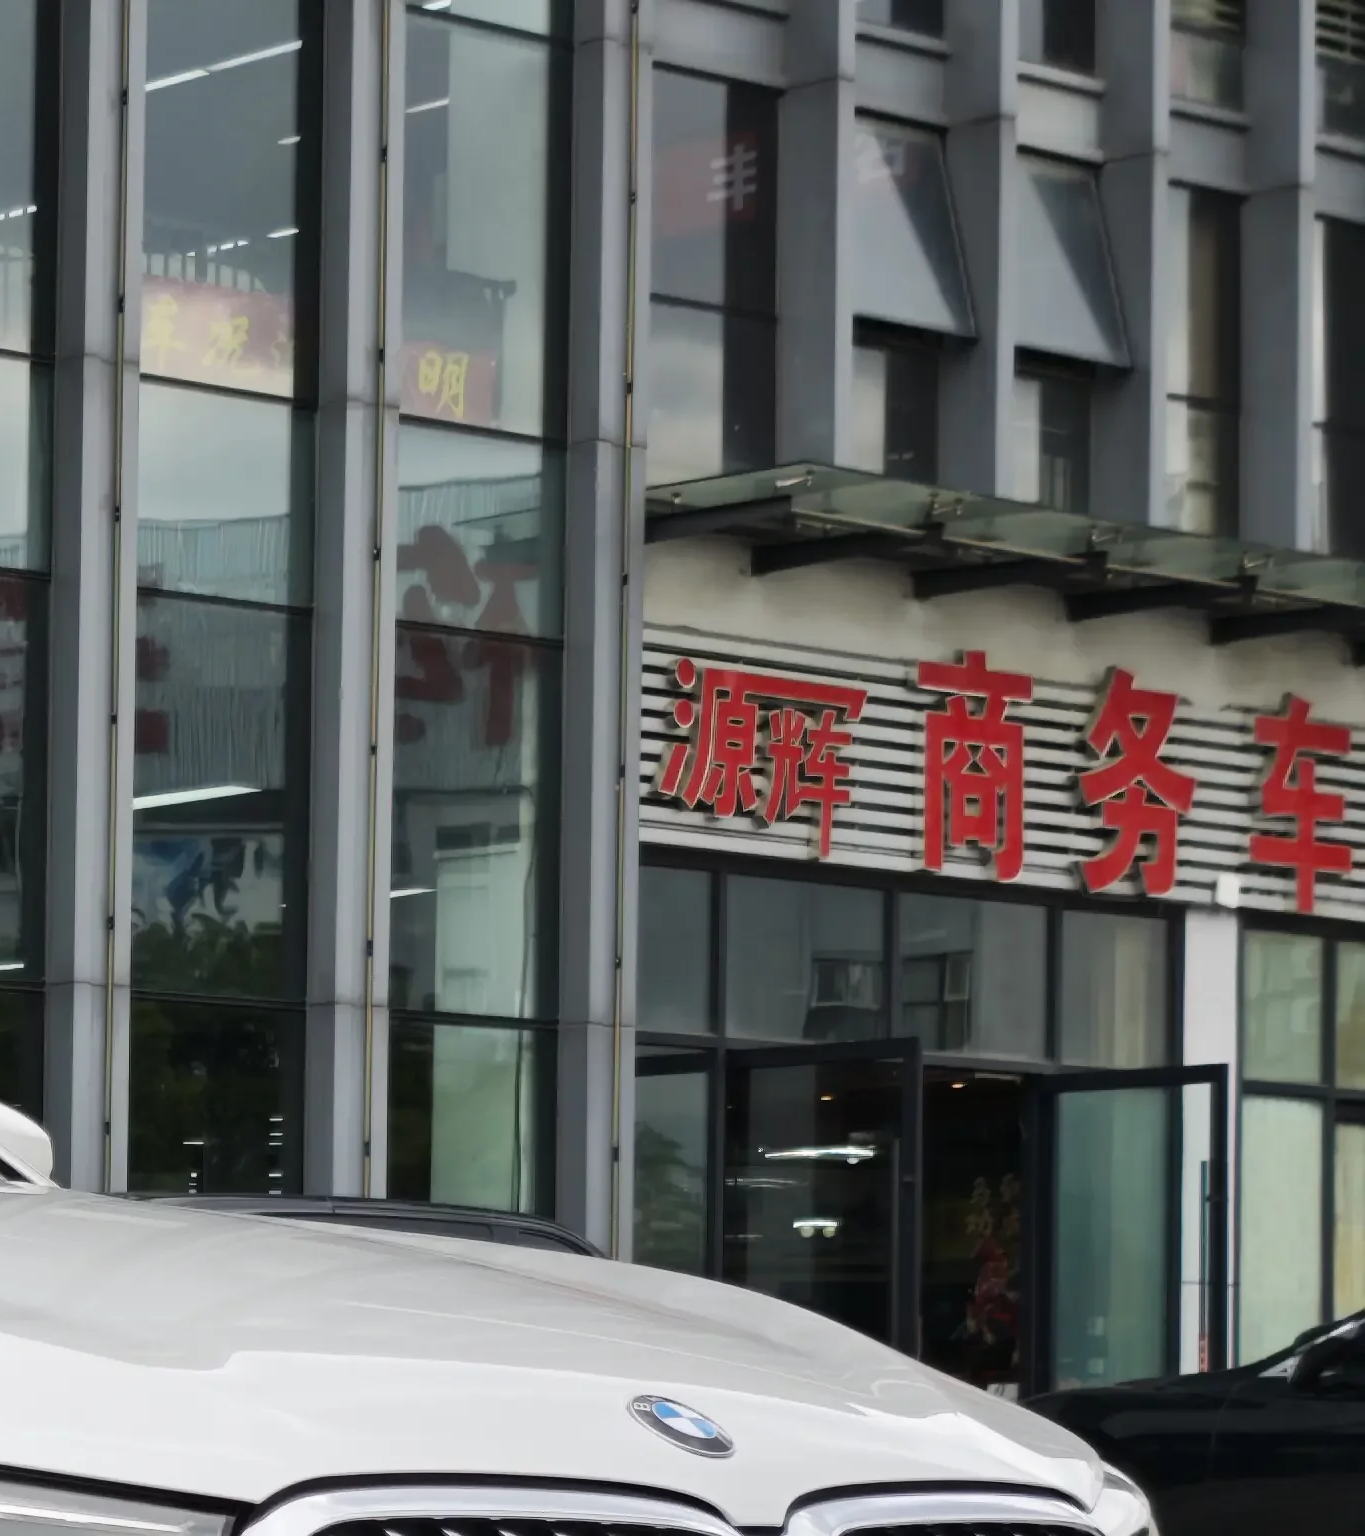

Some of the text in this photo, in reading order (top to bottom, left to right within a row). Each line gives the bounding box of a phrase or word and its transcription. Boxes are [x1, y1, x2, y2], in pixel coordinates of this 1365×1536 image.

[656, 650, 1353, 915] 源辉商务车
